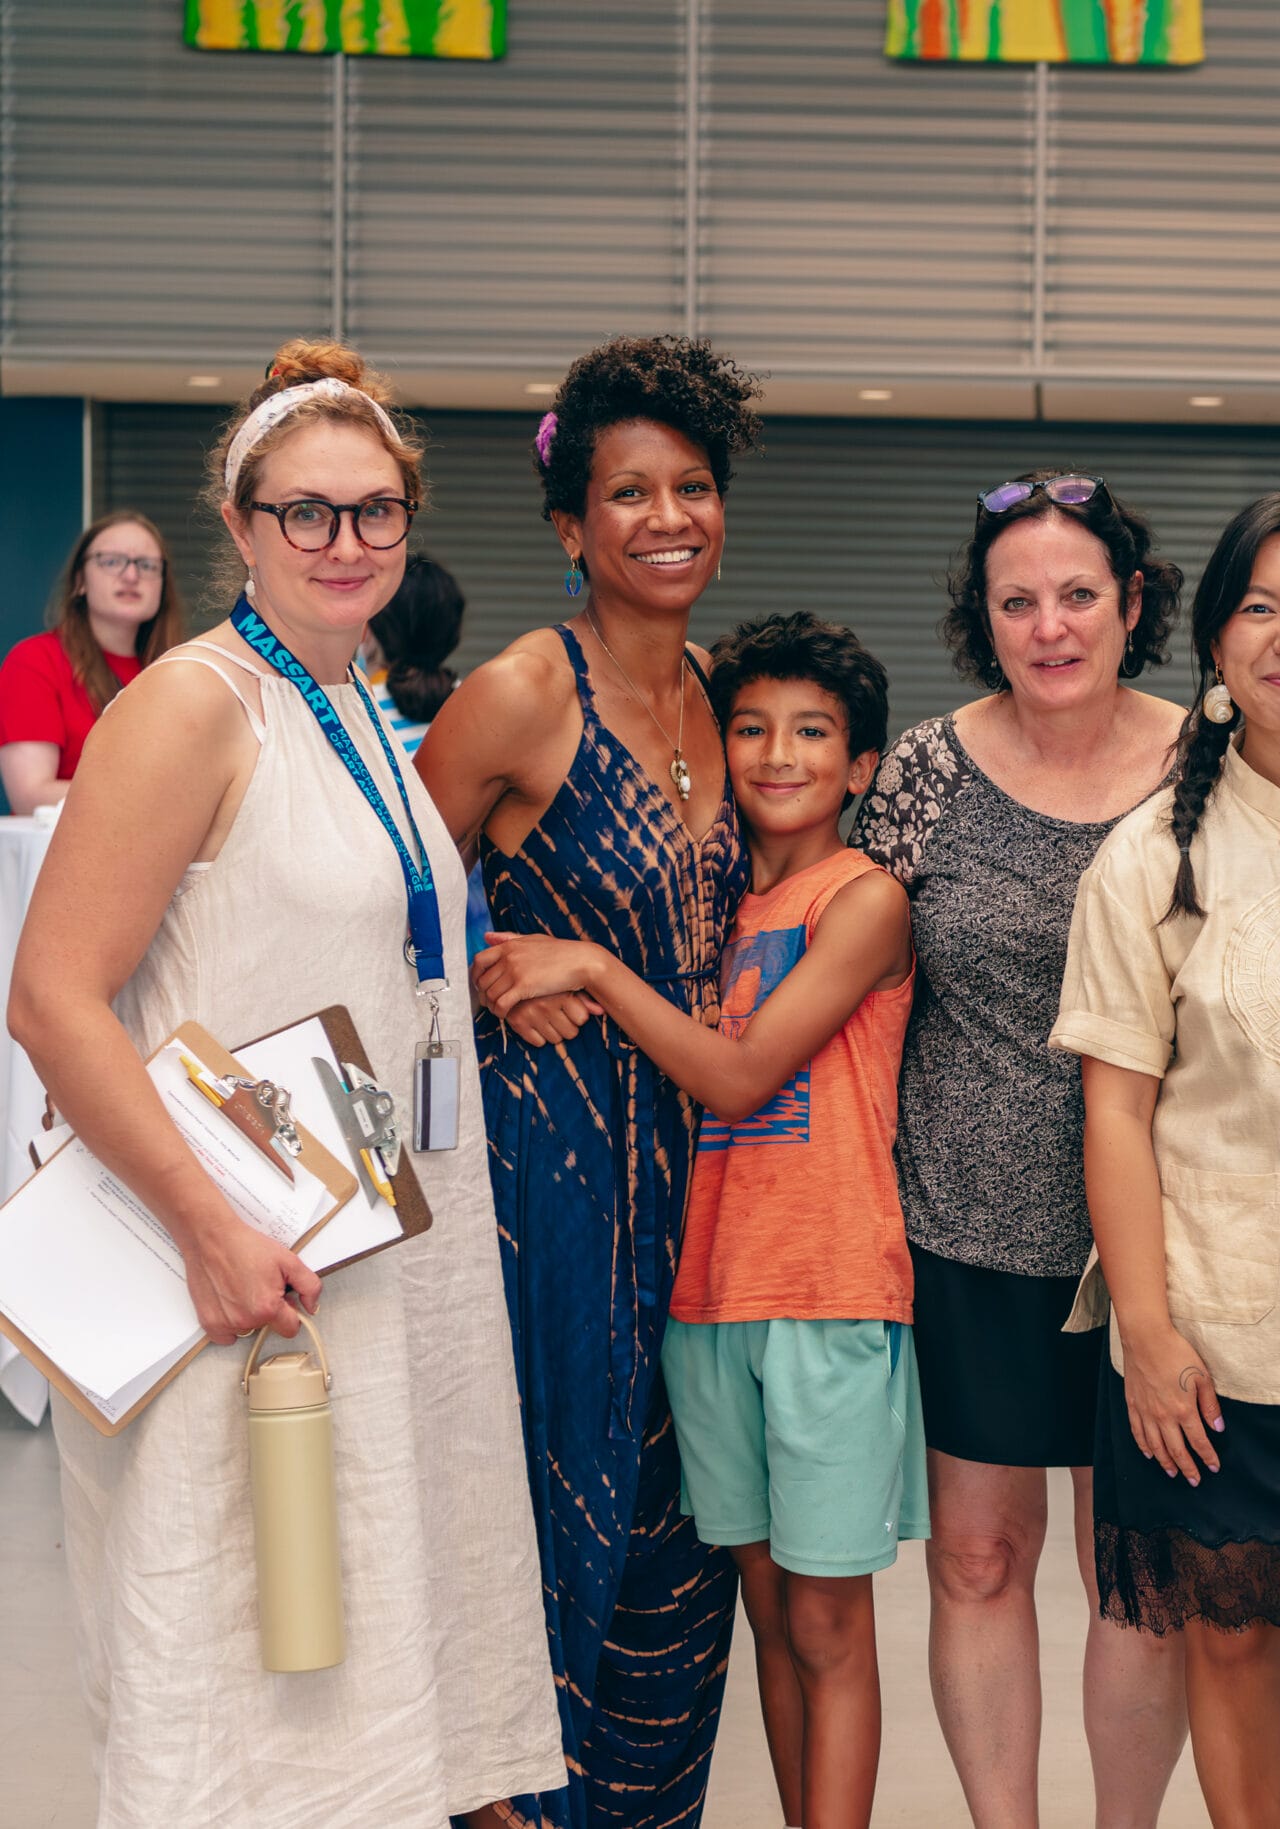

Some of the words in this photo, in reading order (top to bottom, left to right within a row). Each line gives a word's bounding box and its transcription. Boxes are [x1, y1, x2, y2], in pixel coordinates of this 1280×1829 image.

[237, 612, 339, 725] MASSART
[329, 731, 343, 747] OF
[340, 754, 360, 774] ART
[357, 780, 376, 804] AND
[336, 727, 397, 830] MASSACHUSETTS
[395, 834, 423, 892] COLLEGE
